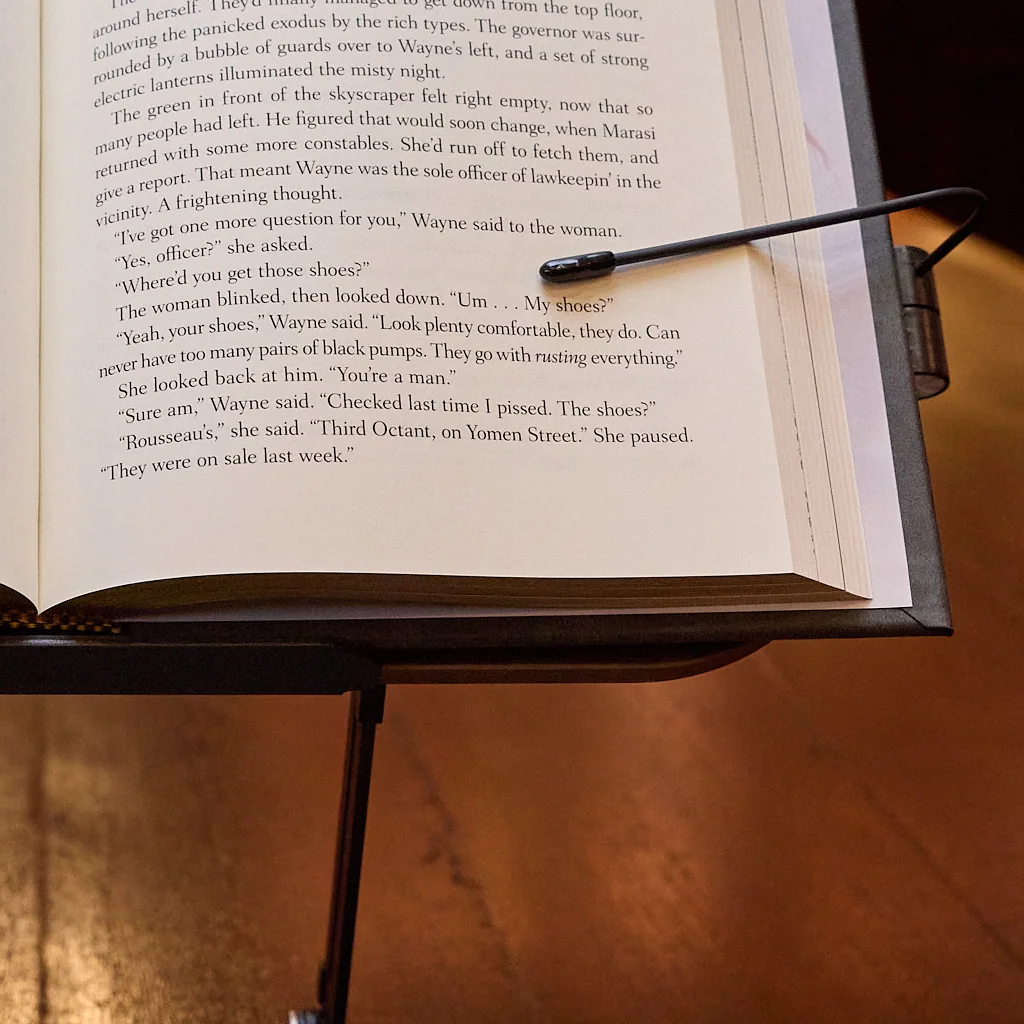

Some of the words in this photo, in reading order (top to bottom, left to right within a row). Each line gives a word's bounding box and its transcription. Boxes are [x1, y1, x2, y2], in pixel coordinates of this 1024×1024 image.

[93, 82, 145, 108] electric
[149, 72, 214, 92] lanterns
[218, 60, 313, 82] illuminated
[318, 60, 345, 76] the
[349, 62, 395, 81] misty
[399, 62, 445, 83] night.
[94, 134, 133, 156] many
[136, 120, 188, 148] people
[192, 114, 223, 133] had
[227, 111, 260, 129] left.
[265, 111, 291, 127] He
[295, 108, 354, 130] figured
[358, 109, 392, 126] that
[395, 111, 444, 128] would
[448, 118, 486, 131] soon
[489, 115, 550, 138] change,
[554, 119, 597, 137] when
[601, 122, 656, 140] Marasi
[94, 204, 152, 227] vicinity.
[157, 196, 171, 213] A
[175, 188, 268, 212] frightening
[272, 183, 342, 204] thought.
[113, 228, 146, 246] “I’ve
[149, 223, 175, 243] got
[178, 220, 209, 234] one
[214, 216, 257, 230] more
[261, 210, 334, 231] question
[338, 208, 362, 226] for
[366, 210, 406, 230] you,”
[410, 211, 467, 233] Wayne
[471, 215, 504, 232] said
[508, 220, 524, 233] to
[528, 217, 555, 235] the
[558, 224, 622, 238] woman.
[114, 253, 151, 270] “Yes,
[155, 238, 222, 263] officer?”
[226, 237, 255, 255] she
[260, 234, 313, 253] asked.
[114, 267, 188, 295] “Where’d
[191, 270, 222, 288] you
[226, 266, 252, 285] get
[257, 261, 304, 278] those
[308, 259, 370, 277] shoes?”
[98, 359, 138, 379] never
[139, 351, 176, 369] have
[179, 349, 206, 363] too
[208, 345, 256, 362] many
[257, 340, 299, 361] pairs
[301, 337, 320, 355] of
[320, 337, 366, 356] black
[367, 344, 427, 362] pumps.
[428, 341, 472, 364] They
[474, 349, 493, 365] go
[495, 345, 532, 363] with
[534, 348, 587, 369] rusting
[589, 347, 683, 369] everything.”
[117, 380, 148, 399] She
[152, 369, 209, 393] looked
[213, 366, 256, 386] back
[260, 369, 278, 383] at
[282, 364, 323, 382] him.
[328, 364, 388, 383] “You’re
[393, 372, 403, 384] a
[407, 368, 456, 385] man.”
[117, 406, 162, 424] “Sure
[166, 396, 204, 417] am,”
[208, 394, 269, 416] Wayne
[274, 391, 314, 410] said.
[318, 391, 403, 410] “Checked
[406, 392, 437, 412] last
[441, 396, 480, 414] time
[484, 397, 492, 414] I
[496, 398, 552, 419] pissed.
[555, 399, 591, 417] The
[595, 399, 656, 417] shoes?”
[99, 461, 147, 481] “They
[150, 457, 191, 472] were
[196, 454, 218, 467] on
[223, 446, 257, 466] sale
[262, 446, 294, 464] last
[298, 445, 354, 463] week.”
